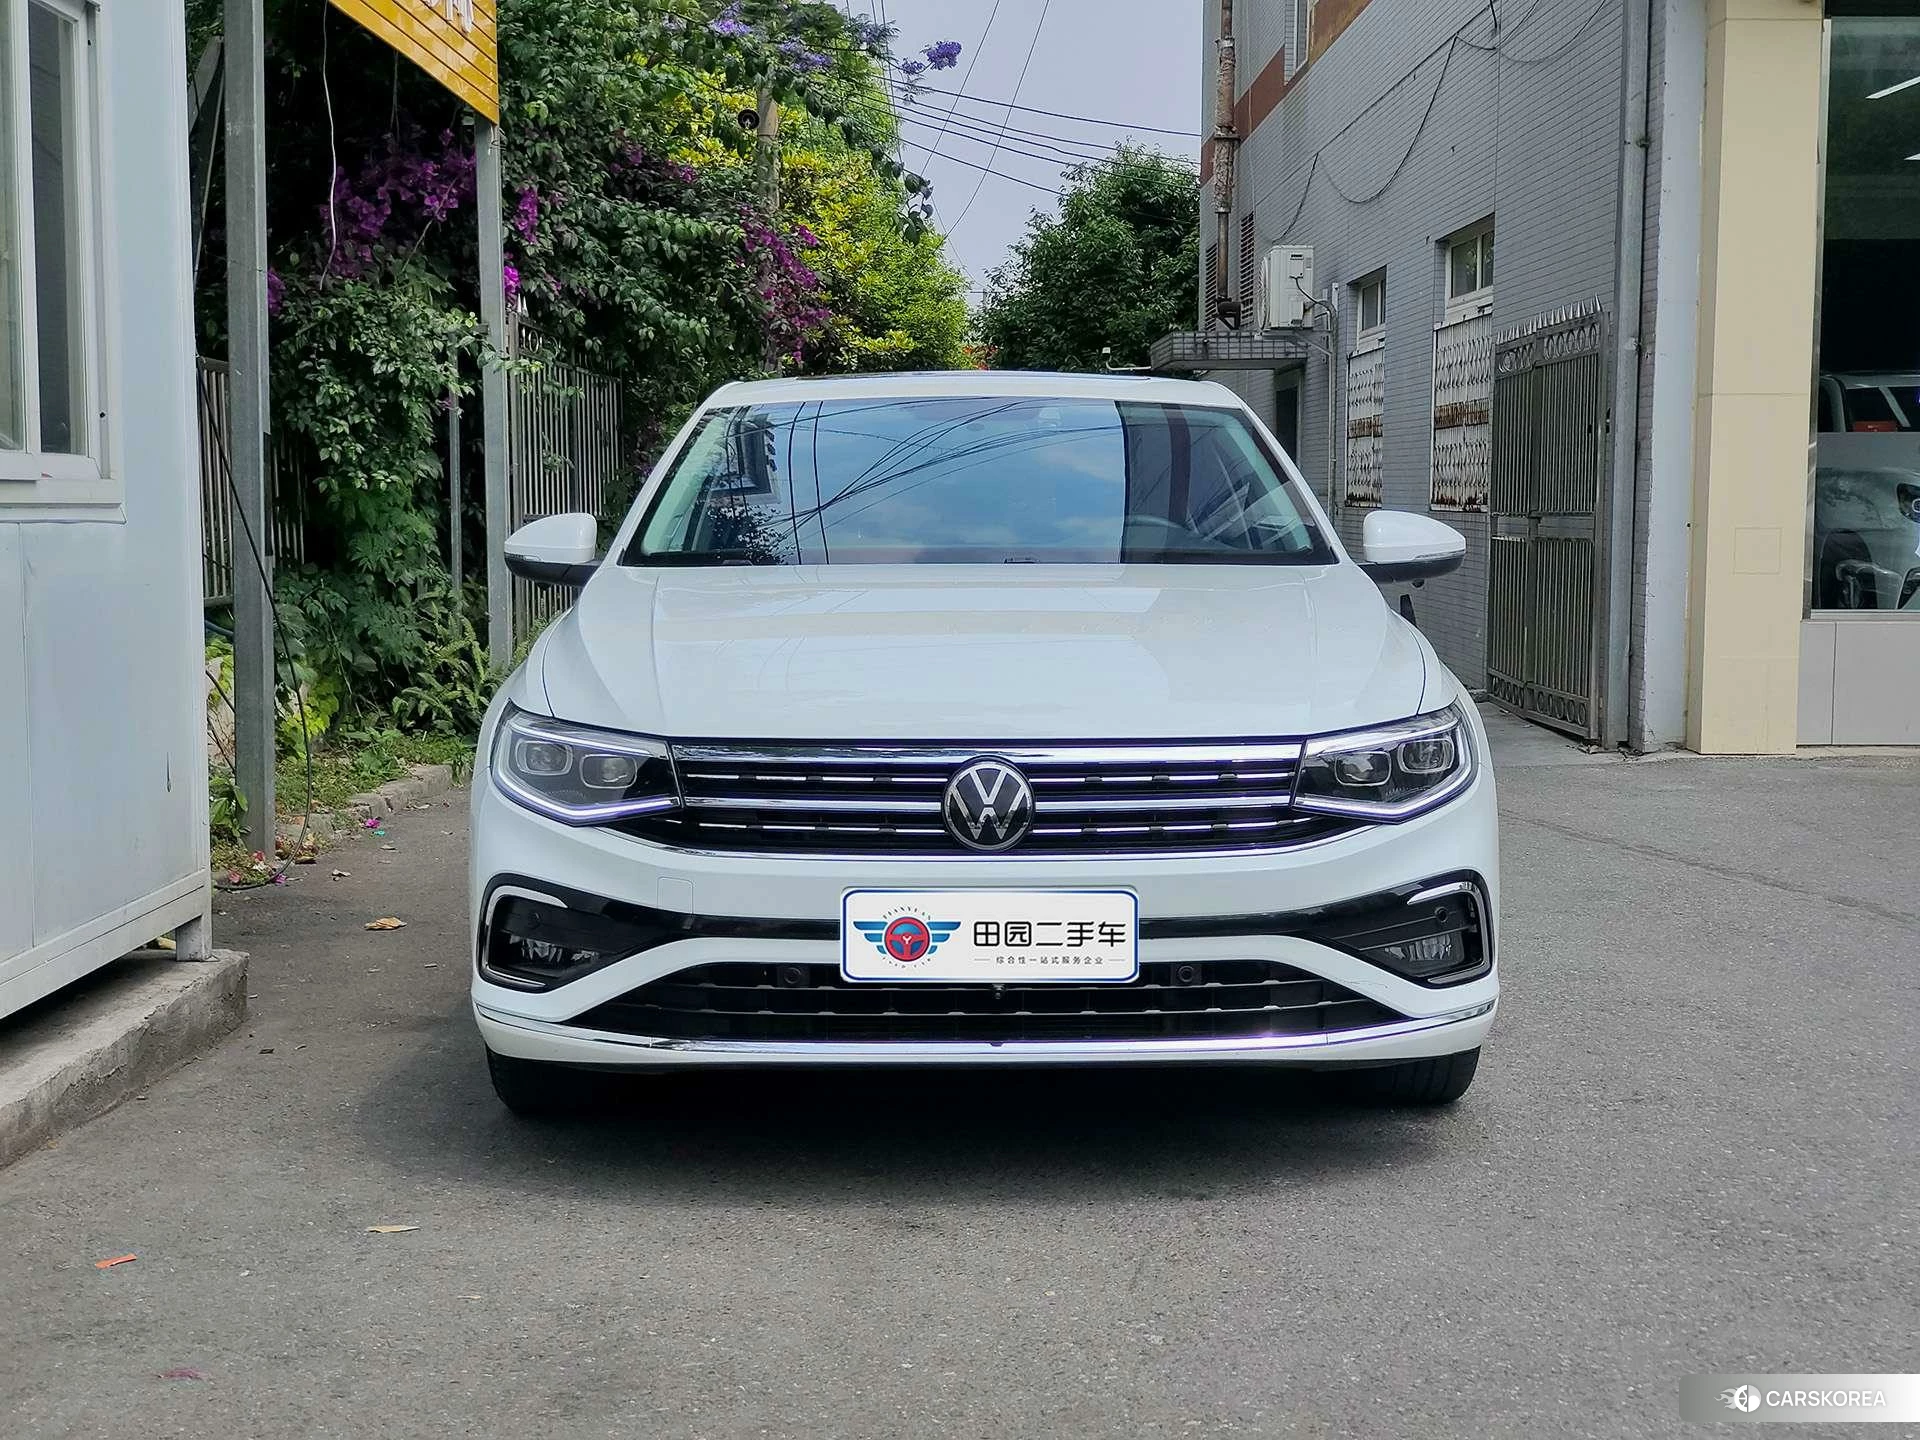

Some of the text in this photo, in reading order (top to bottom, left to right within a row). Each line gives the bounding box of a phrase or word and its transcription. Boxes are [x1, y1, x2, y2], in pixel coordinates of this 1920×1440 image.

[973, 920, 1127, 948] 田园二手车
[995, 955, 1104, 966] 综合性一站式服务企业
